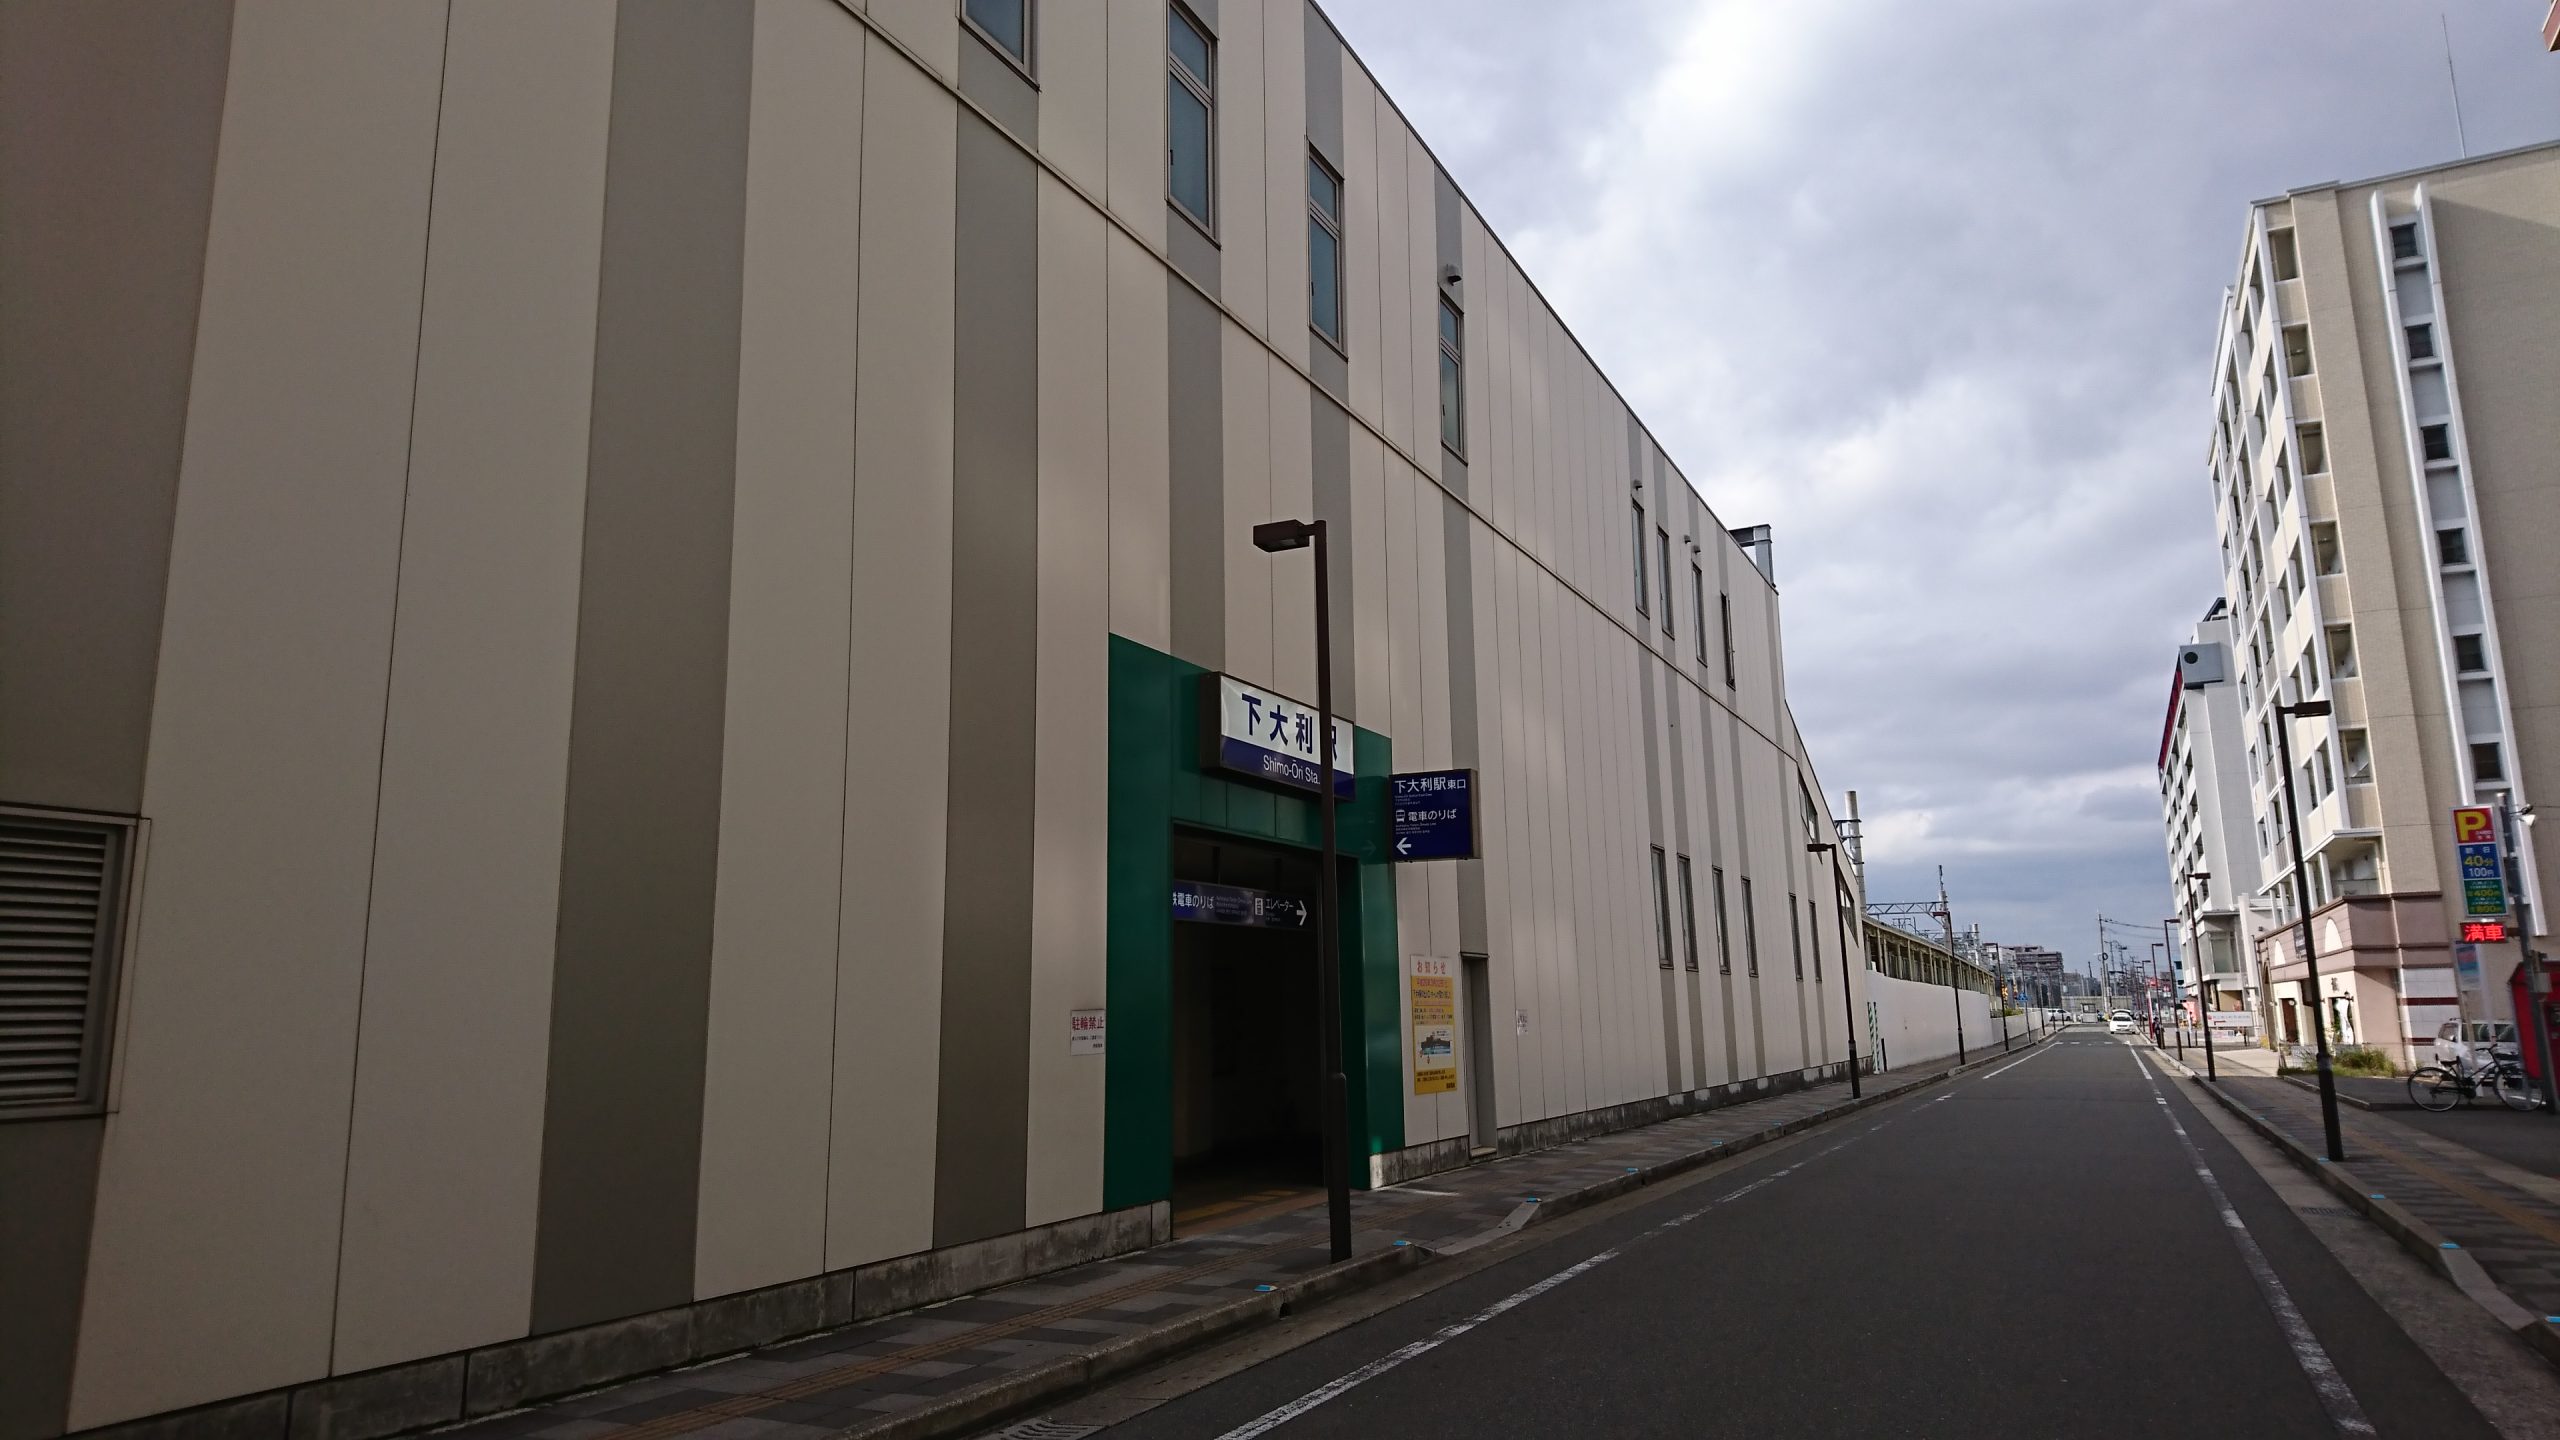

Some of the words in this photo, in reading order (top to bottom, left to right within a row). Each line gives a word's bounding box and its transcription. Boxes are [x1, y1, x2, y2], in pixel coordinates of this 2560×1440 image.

[1394, 776, 1467, 794] 下大利駅東口
[1407, 808, 1457, 822] 電車のりば
[2456, 811, 2487, 841] P
[2468, 867, 2495, 878] 100円
[1265, 897, 1295, 912] エレベーター
[2465, 924, 2505, 942] 満車
[1416, 960, 1447, 975] お知らせ
[1072, 1016, 1104, 1031] 駐輪禁止
